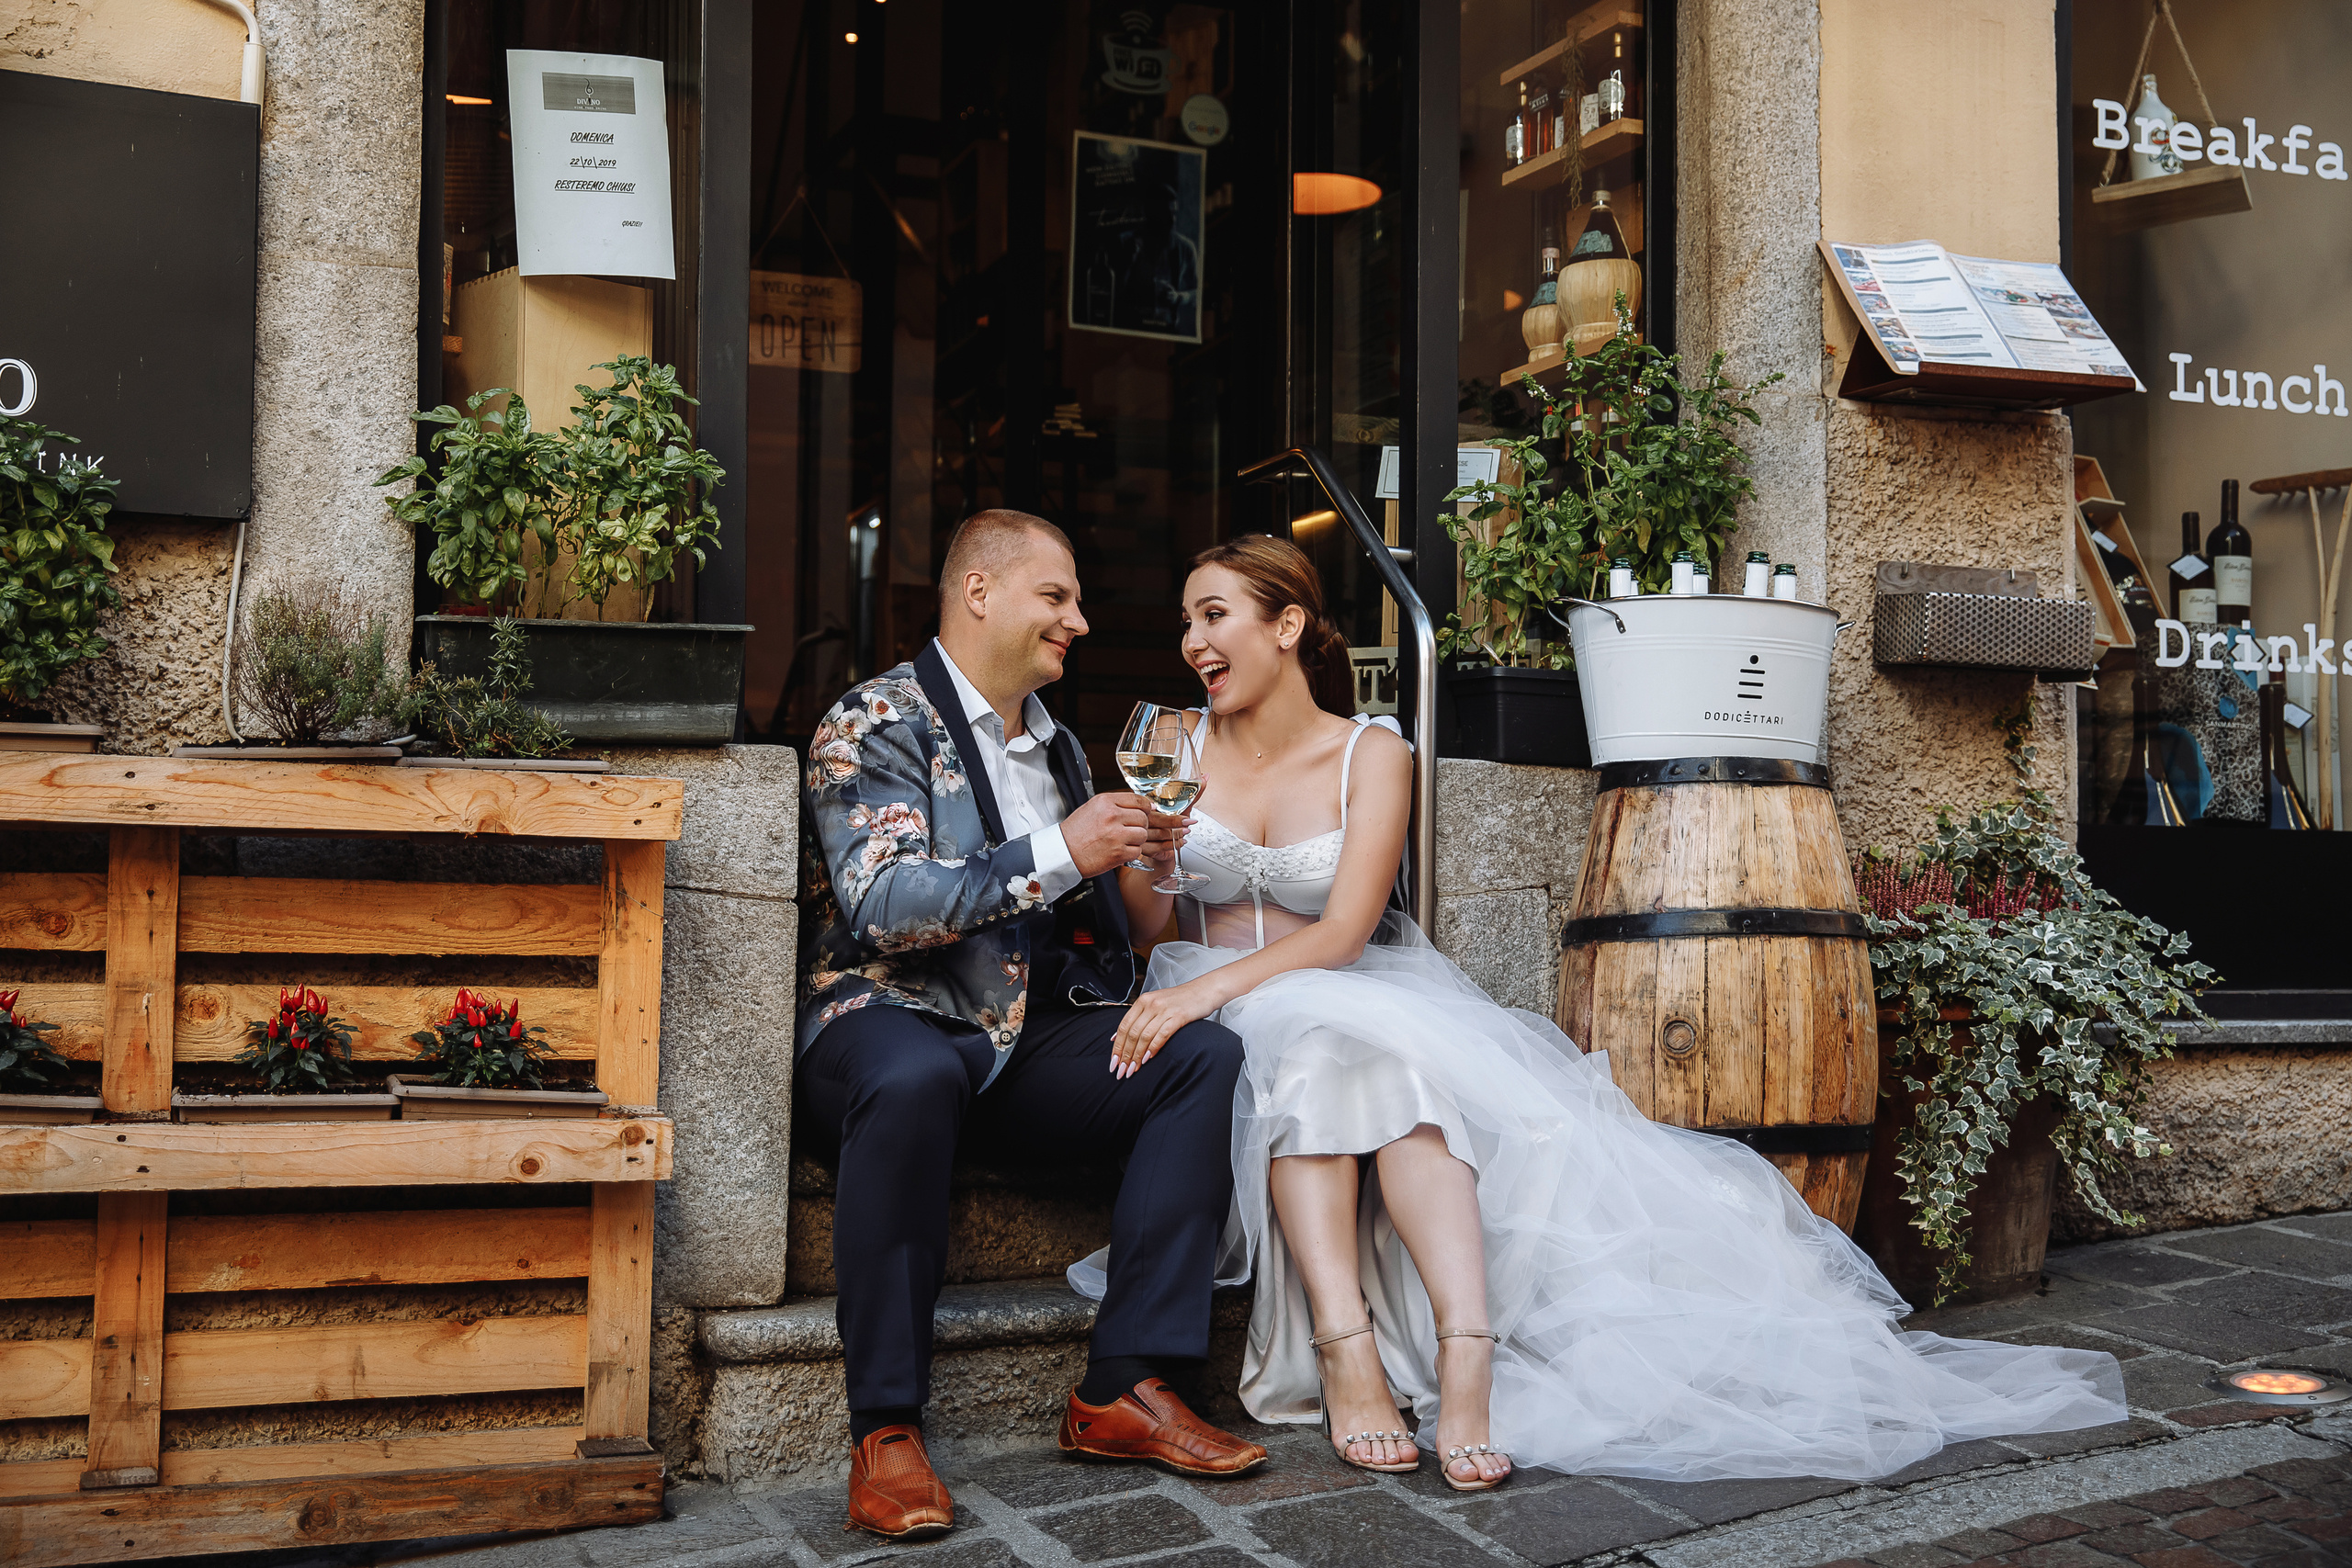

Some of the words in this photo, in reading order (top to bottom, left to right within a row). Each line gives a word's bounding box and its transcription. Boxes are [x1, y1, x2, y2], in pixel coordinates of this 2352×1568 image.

[570, 131, 615, 143] DOMENICA
[2091, 97, 2349, 181] Breakfa
[554, 179, 605, 191] RESTEREMO
[605, 181, 637, 192] CHIUSI
[761, 281, 834, 299] WELCOME
[760, 313, 836, 363] OPEN
[2167, 352, 2349, 418] Lunch
